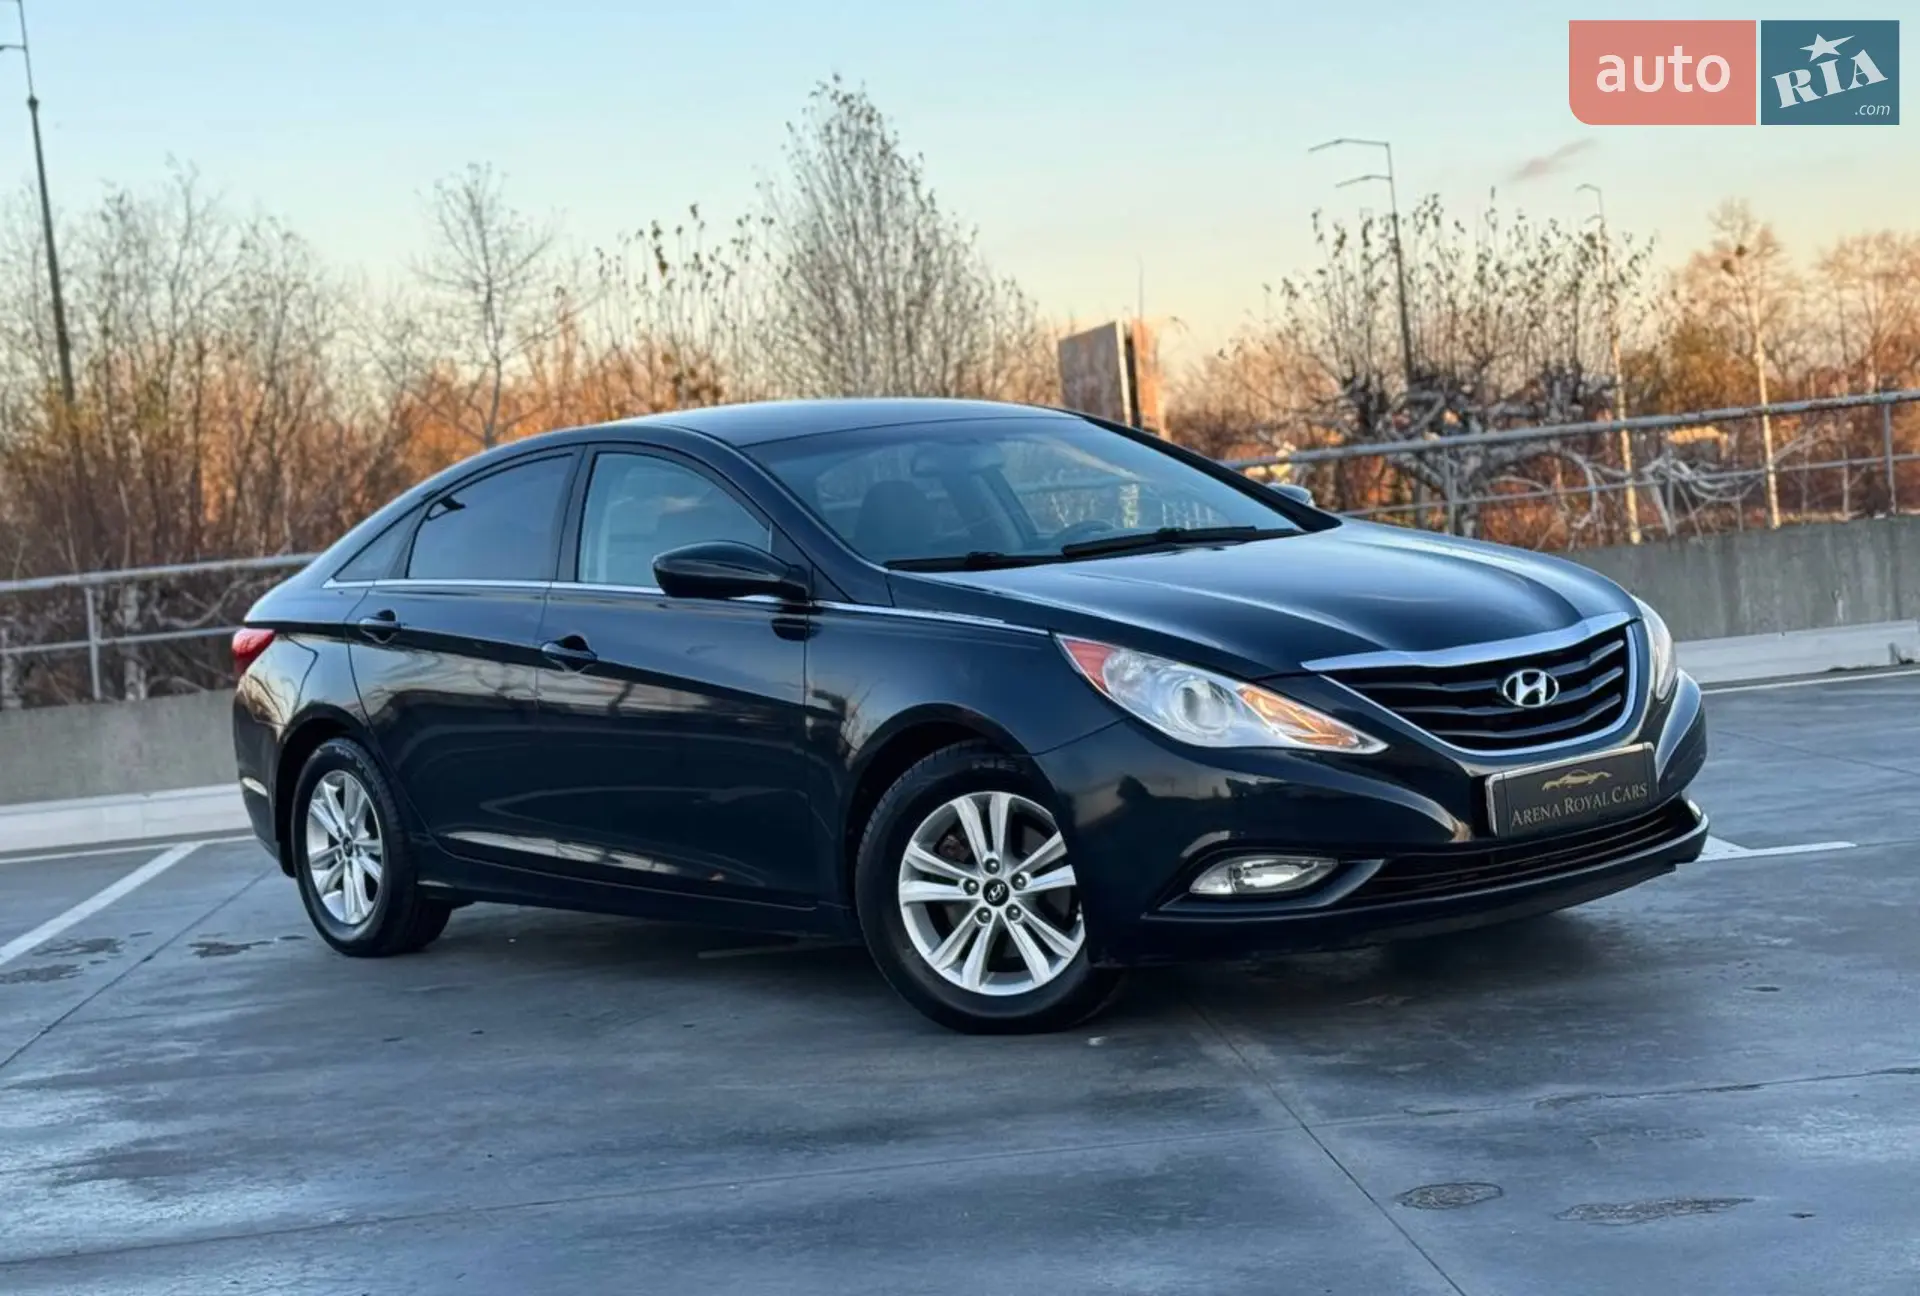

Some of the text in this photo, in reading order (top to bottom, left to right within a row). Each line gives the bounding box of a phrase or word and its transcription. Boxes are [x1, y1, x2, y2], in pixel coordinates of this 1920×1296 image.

[1511, 782, 1648, 827] ARENA ROYAL CARS
